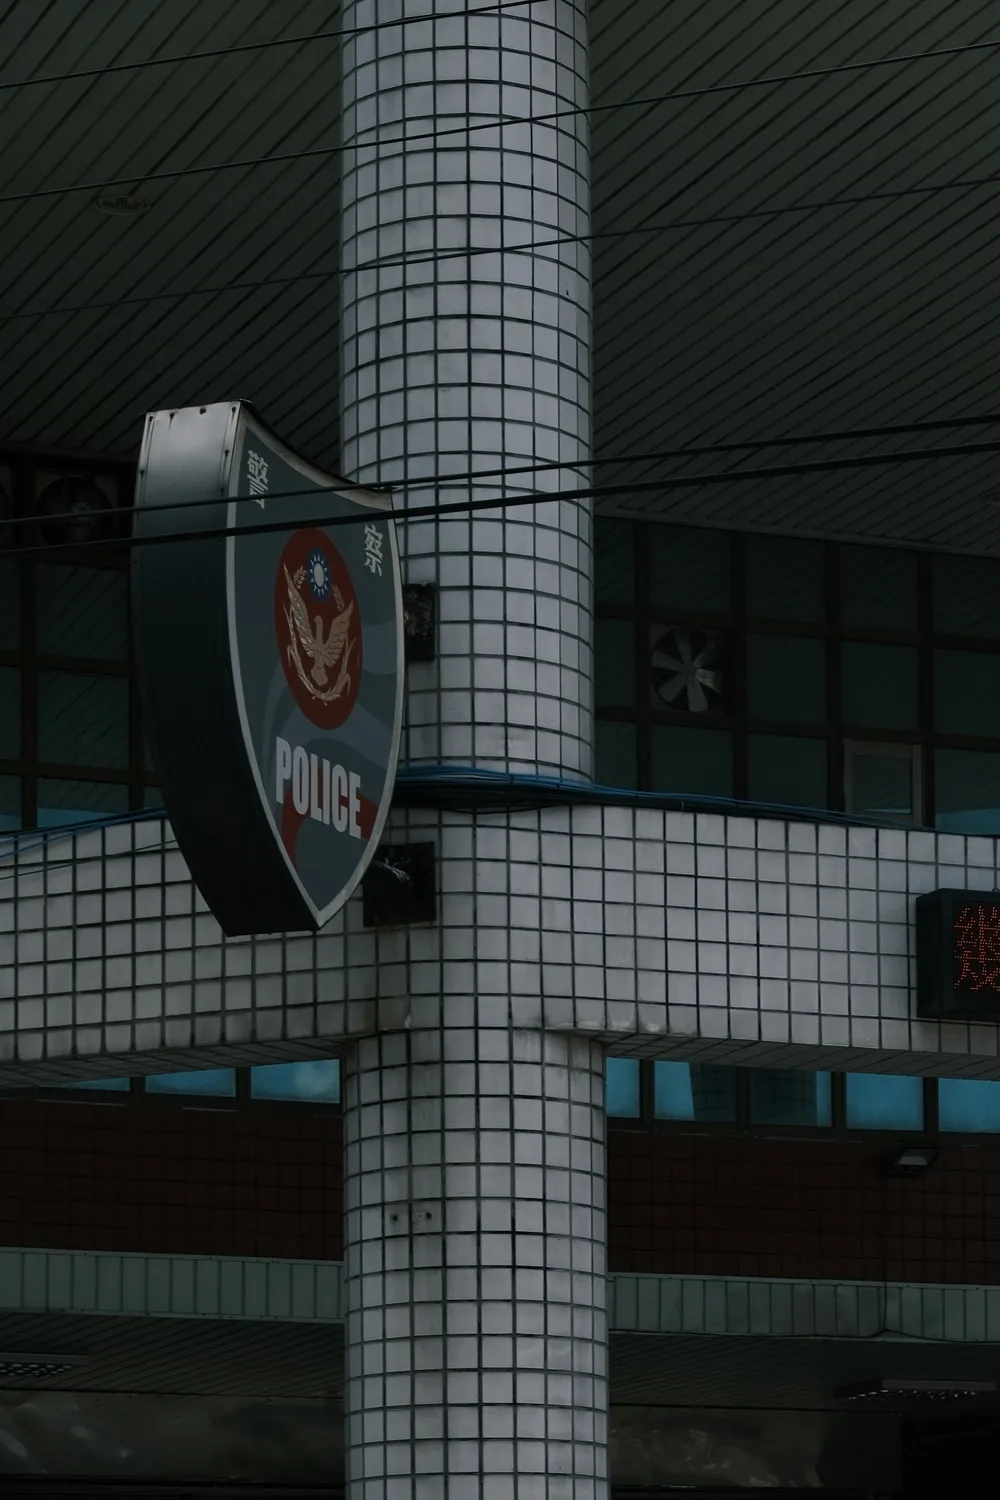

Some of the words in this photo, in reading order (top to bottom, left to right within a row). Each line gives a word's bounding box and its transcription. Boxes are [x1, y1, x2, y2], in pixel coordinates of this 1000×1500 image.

[246, 449, 269, 510] 警
[363, 523, 384, 579] 察
[276, 736, 361, 839] POLICE
